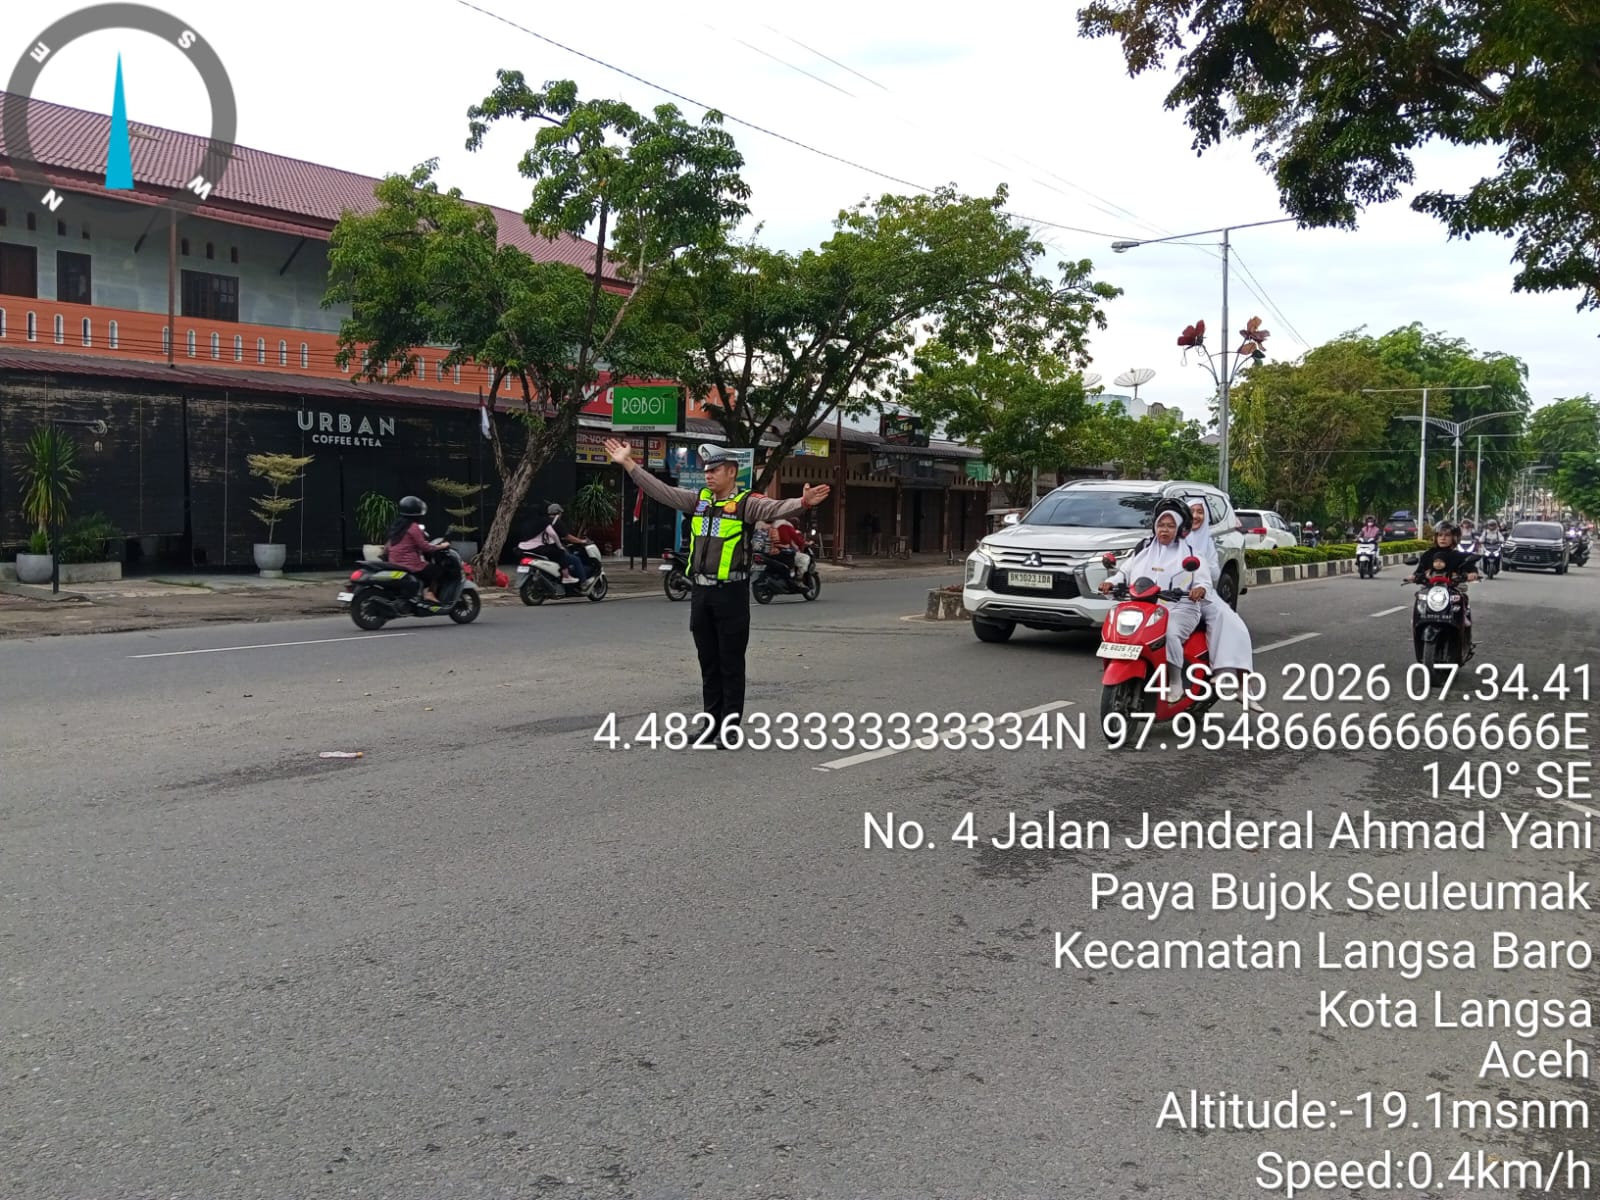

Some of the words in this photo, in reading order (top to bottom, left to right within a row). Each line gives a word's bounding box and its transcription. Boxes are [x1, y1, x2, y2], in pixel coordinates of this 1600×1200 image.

[621, 396, 666, 415] ROBOT
[297, 410, 395, 436] URBAN
[312, 434, 352, 446] COFFEE
[353, 437, 360, 446] &
[361, 437, 382, 447] TEA
